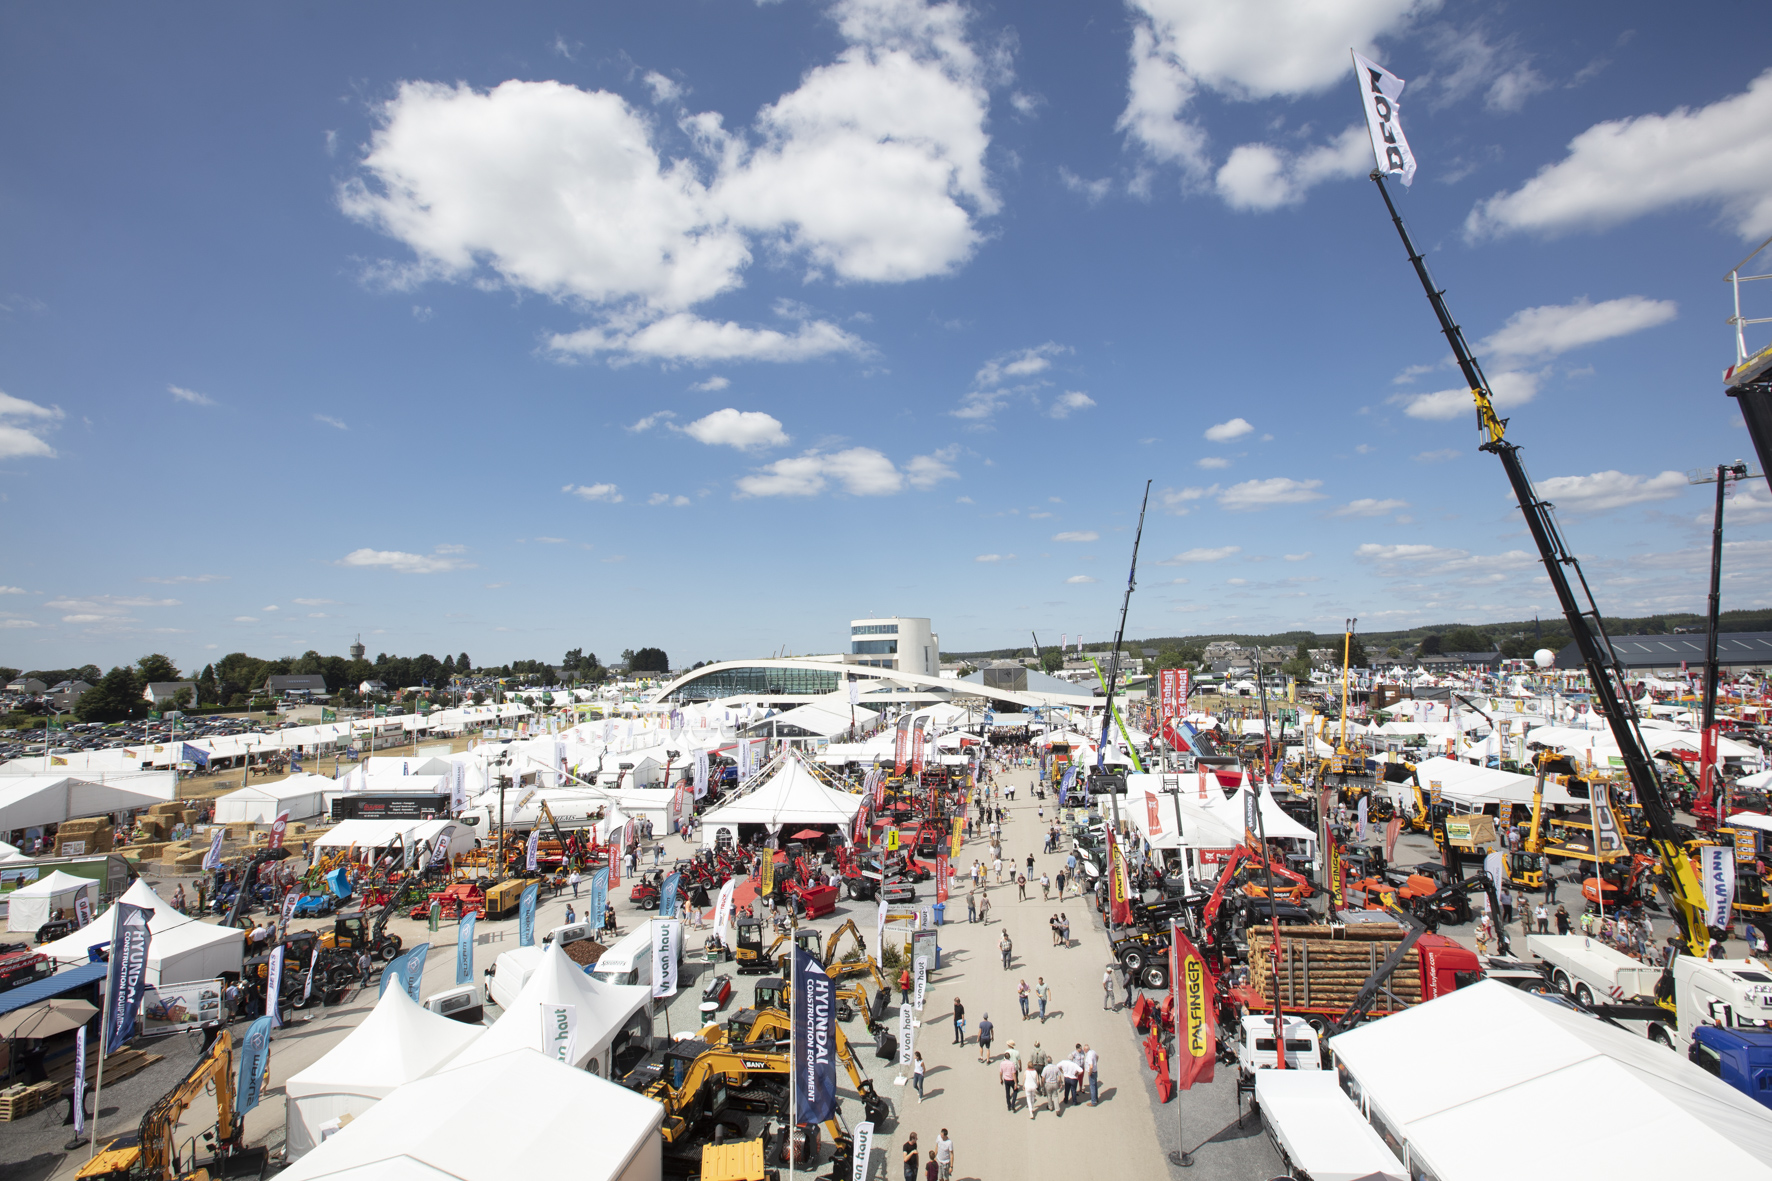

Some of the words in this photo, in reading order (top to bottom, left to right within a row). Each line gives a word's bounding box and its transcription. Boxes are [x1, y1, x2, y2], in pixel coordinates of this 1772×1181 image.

[1594, 784, 1620, 849] JCB
[1713, 850, 1727, 925] AHLMANN
[119, 931, 131, 987] CONSTRUCTION
[659, 923, 671, 953] haut
[126, 930, 146, 1004] HYUNDAI
[660, 957, 670, 978] van
[554, 1008, 568, 1042] haut
[816, 980, 829, 1065] HYUNDAI
[1187, 960, 1204, 1050] PALFINGER
[746, 1061, 765, 1069] SANY
[807, 1050, 815, 1102] EQUIPMENT
[855, 1129, 869, 1160] haut
